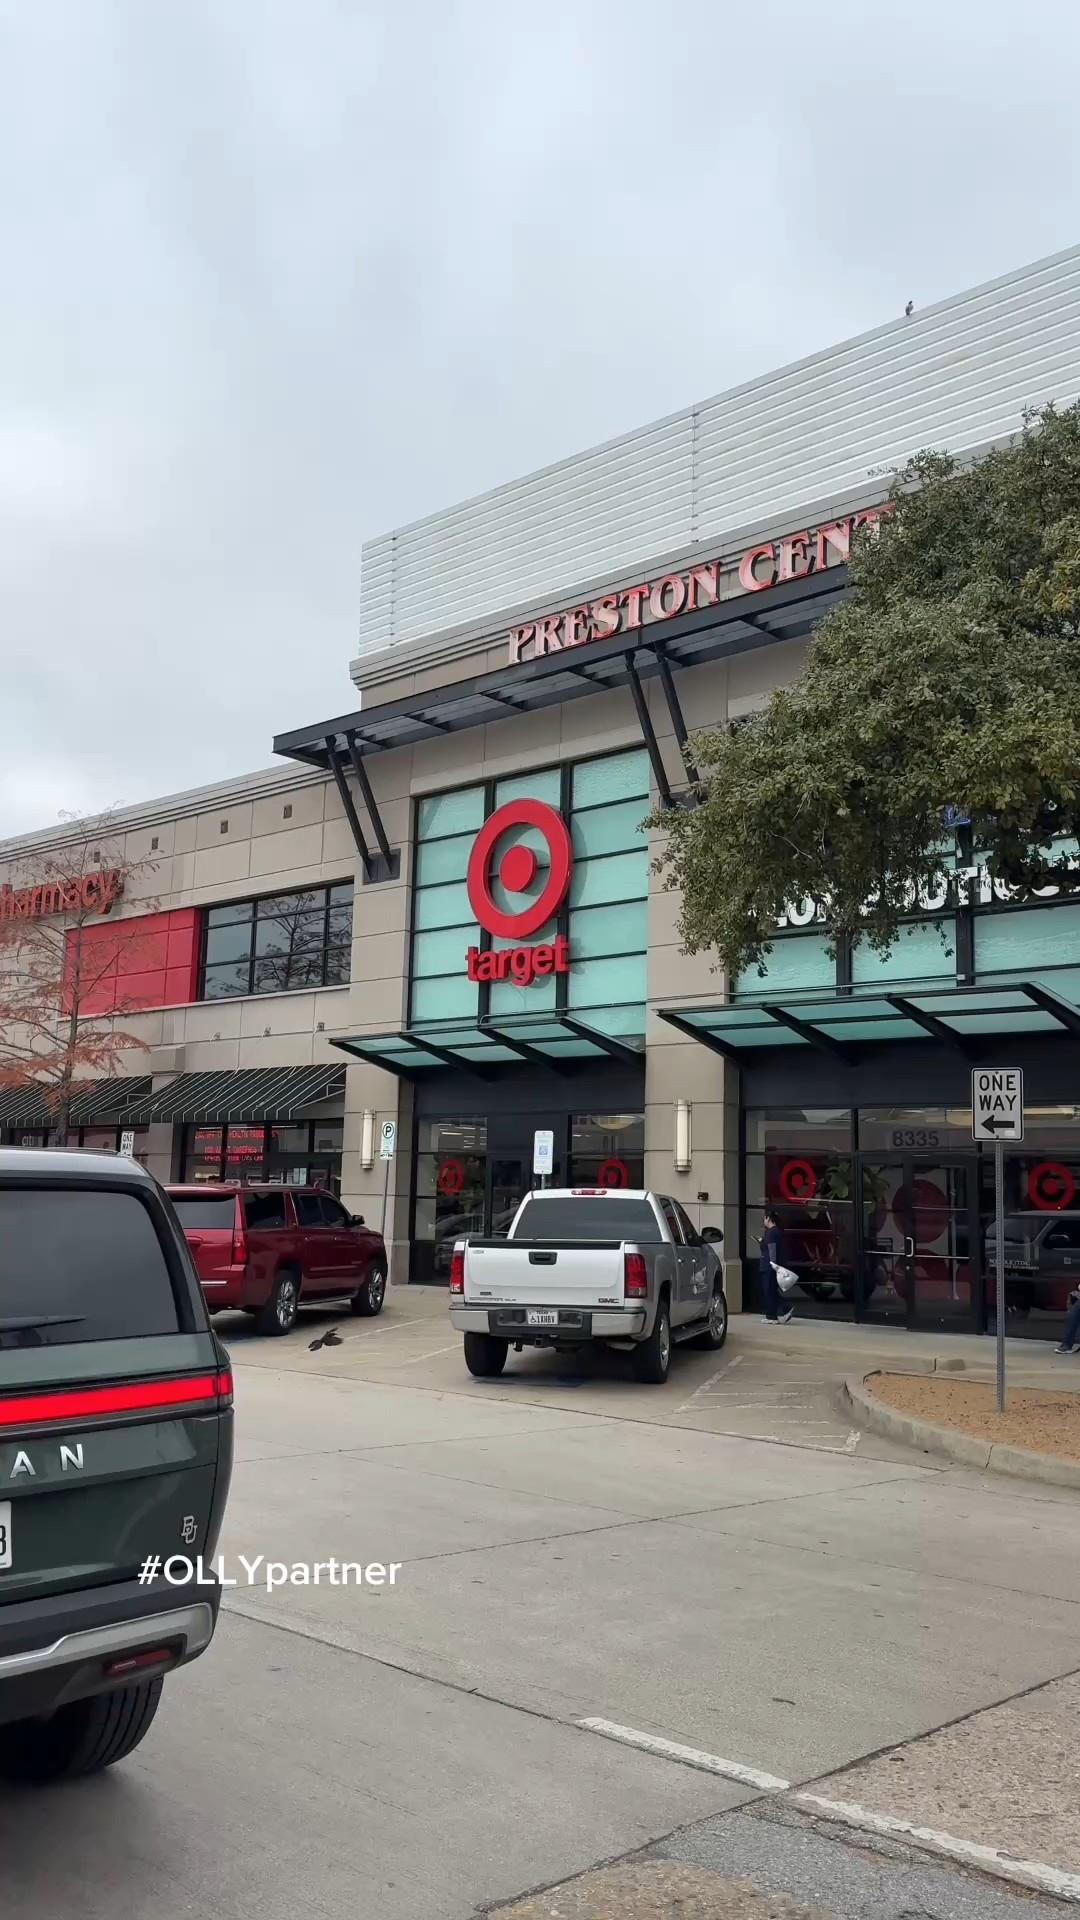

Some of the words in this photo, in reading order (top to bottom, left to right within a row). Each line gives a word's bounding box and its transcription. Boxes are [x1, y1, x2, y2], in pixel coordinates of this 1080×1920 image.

[508, 560, 721, 666] PRESTON
[465, 935, 569, 986] target
[979, 1074, 1017, 1091] ONE
[979, 1095, 1017, 1111] WAY
[892, 1130, 939, 1147] 8335
